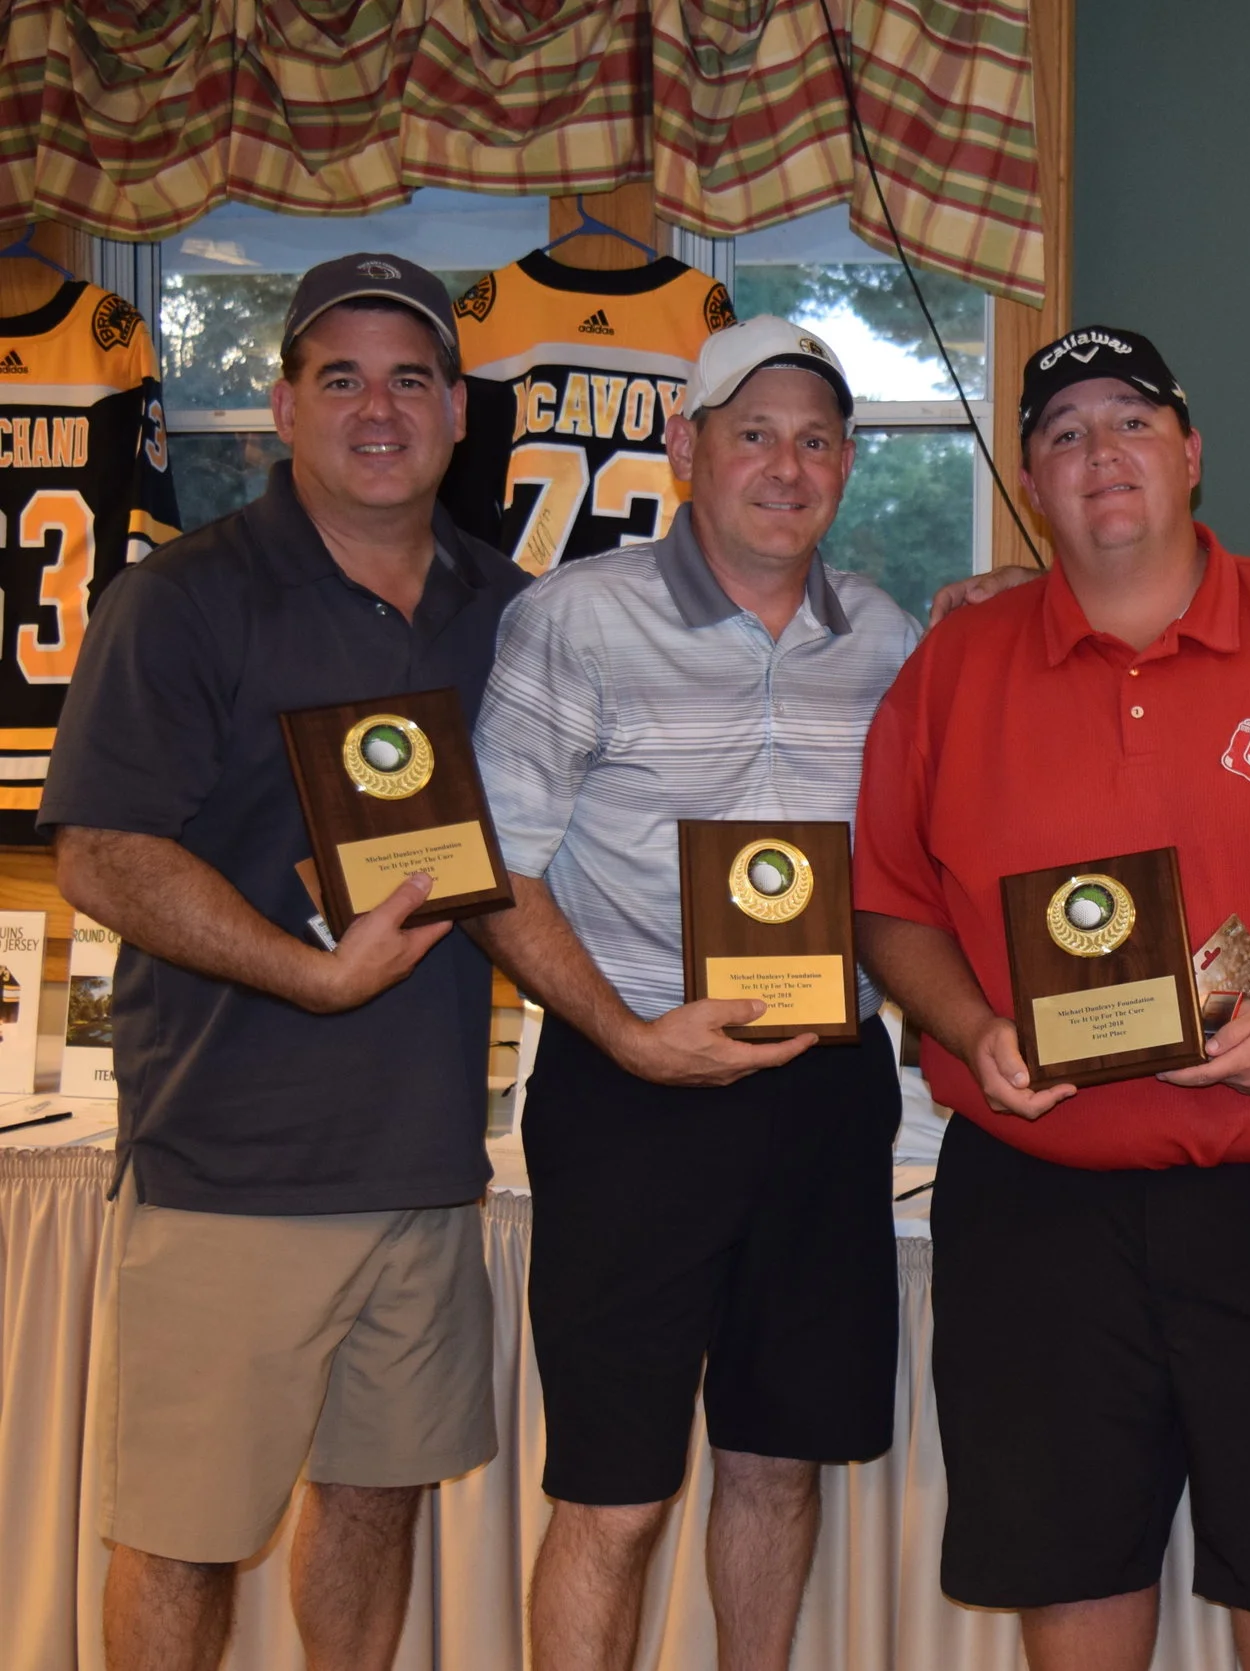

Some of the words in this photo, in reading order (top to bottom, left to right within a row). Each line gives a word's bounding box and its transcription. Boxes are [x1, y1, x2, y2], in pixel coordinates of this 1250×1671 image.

[577, 325, 615, 336] adidas
[1039, 331, 1133, 371] Callaway
[503, 442, 680, 578] 73
[0, 489, 96, 685] 3
[365, 854, 392, 864] Michael
[425, 842, 462, 853] Foundation
[423, 856, 436, 864] The
[73, 928, 105, 943] ROUND
[3, 939, 40, 952] JERSEY
[1057, 1007, 1084, 1017] Michael
[1117, 996, 1155, 1008] Foundation
[1101, 1012, 1113, 1020] For
[1128, 1007, 1145, 1015] Cure
[1092, 1023, 1107, 1031] Sept
[1109, 1020, 1124, 1028] 2018
[1109, 1030, 1127, 1038] Place
